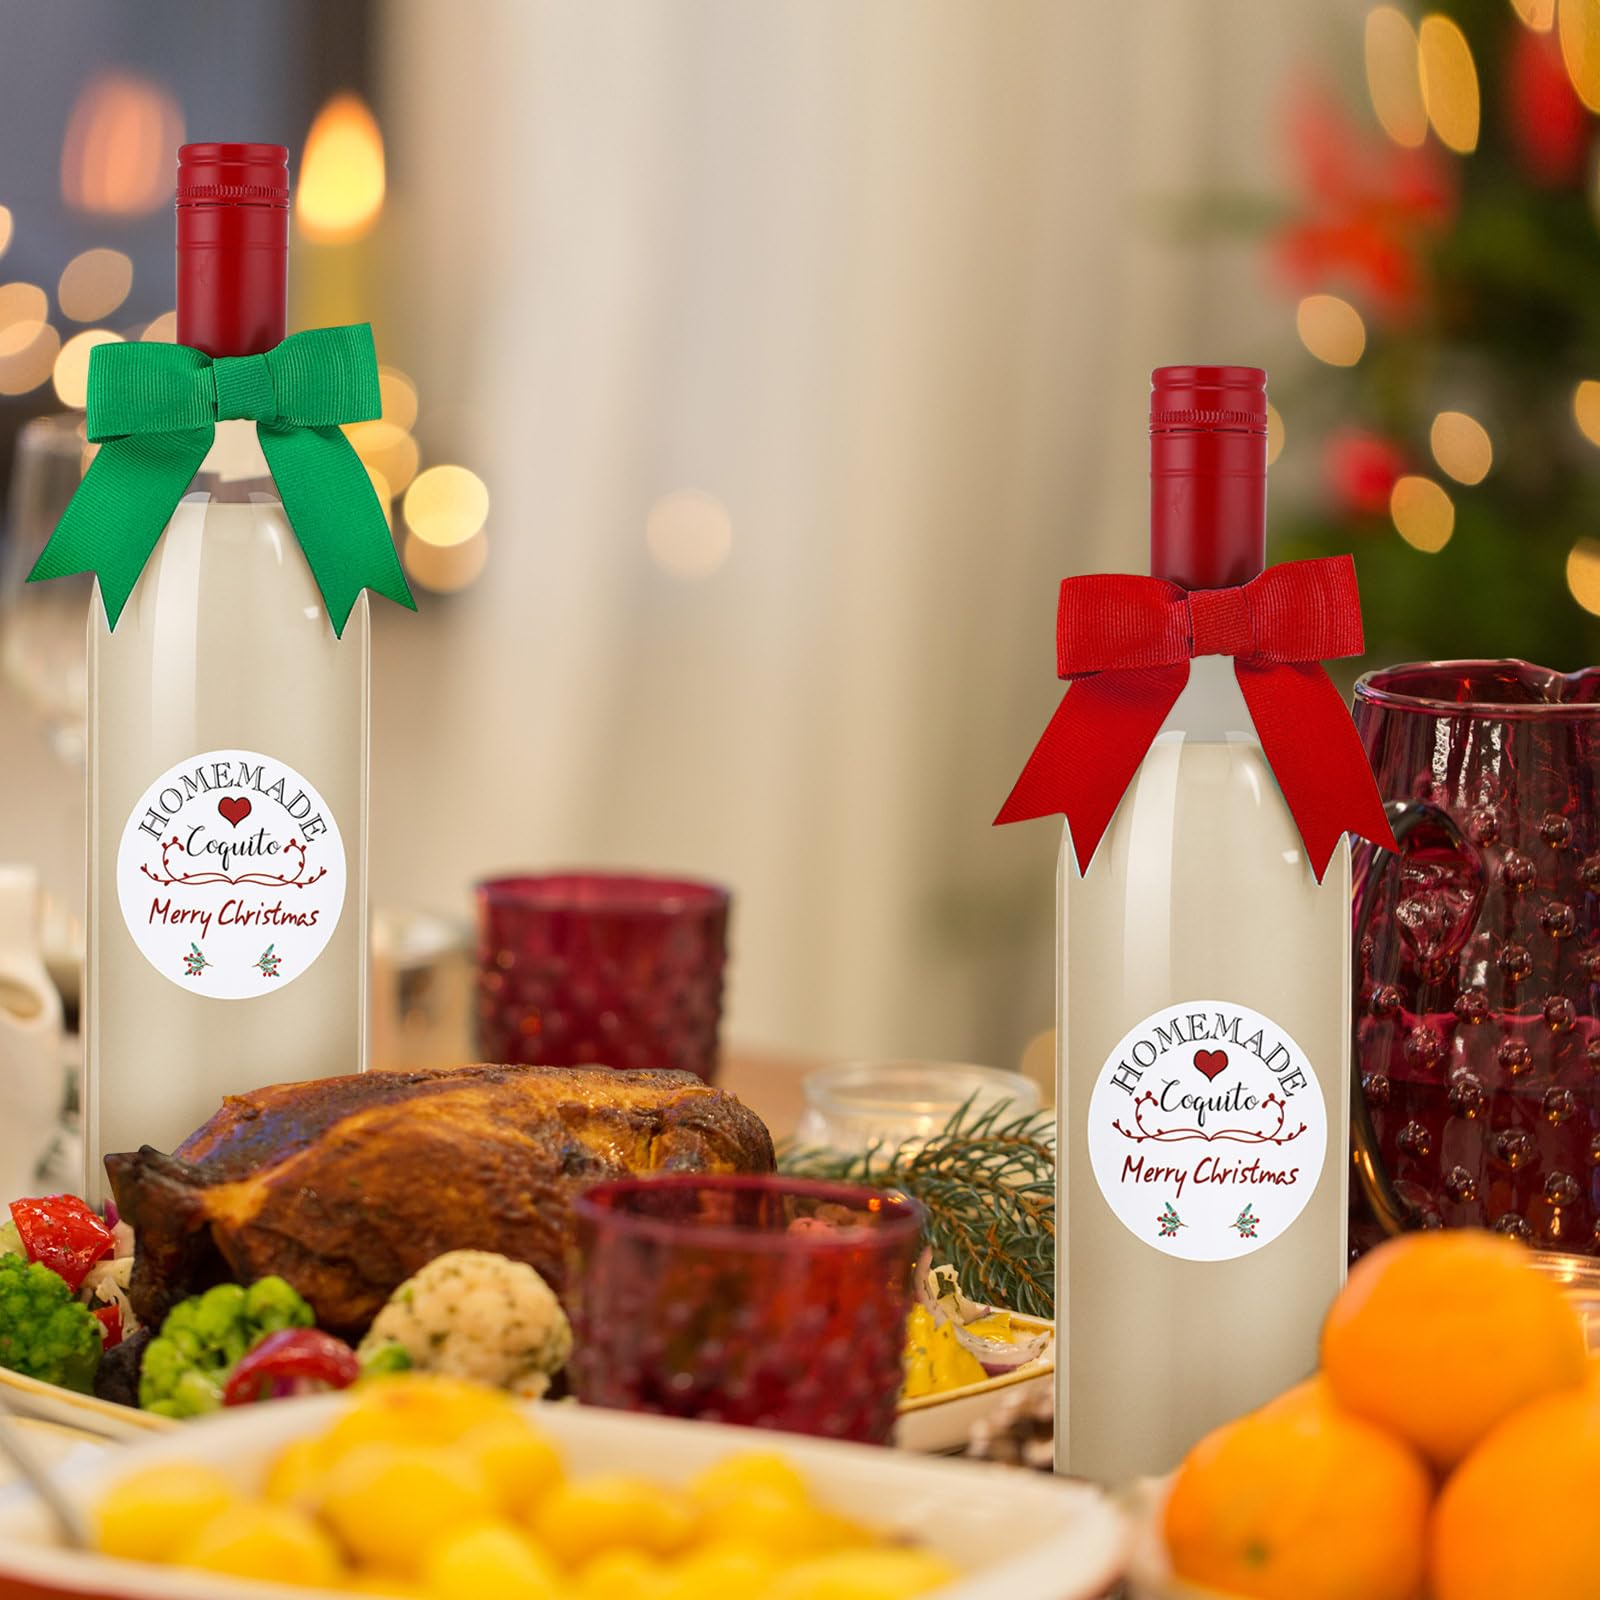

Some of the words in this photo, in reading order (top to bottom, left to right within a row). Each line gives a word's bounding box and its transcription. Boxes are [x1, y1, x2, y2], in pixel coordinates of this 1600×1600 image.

[138, 761, 328, 843] HOMEMADE
[186, 825, 282, 871] Coquito
[149, 898, 212, 939] Merry
[218, 899, 319, 926] Christmas
[1109, 1012, 1308, 1097] HOMEMADE
[1160, 1079, 1260, 1127] Coquito
[1121, 1155, 1187, 1198] Merry
[1193, 1157, 1299, 1185] Christmas
